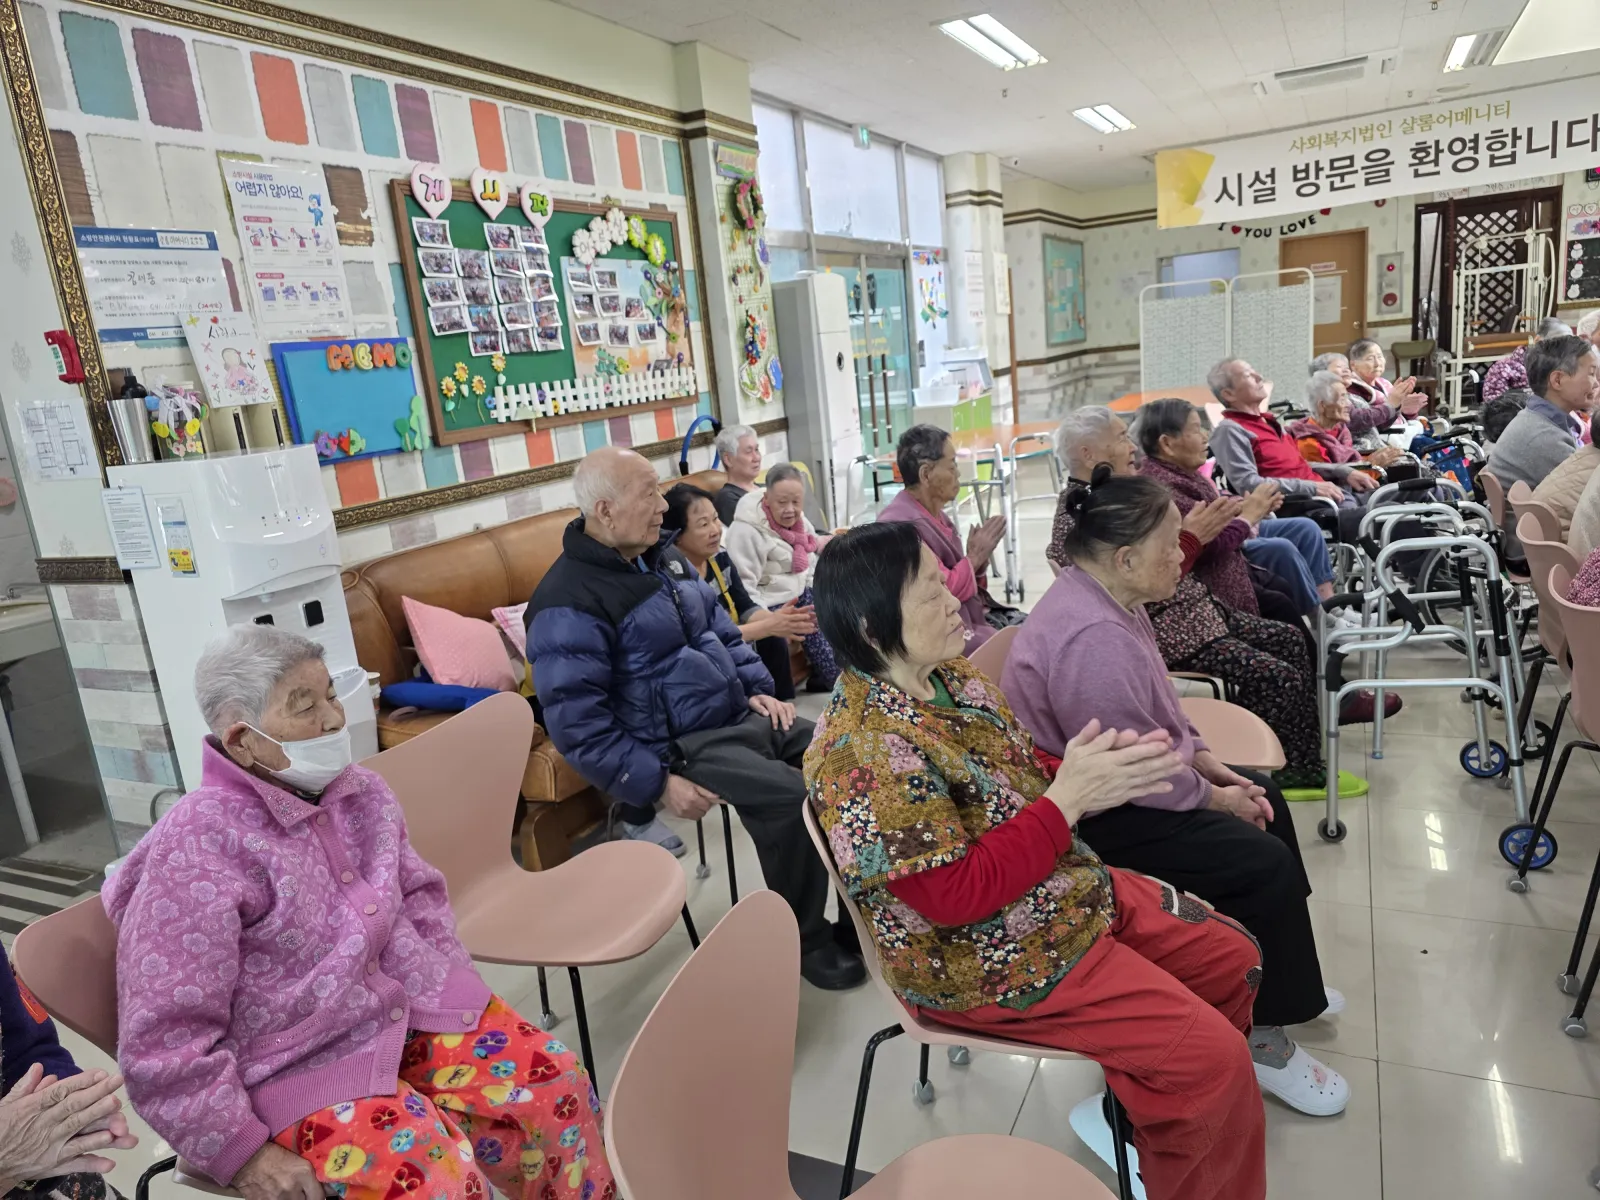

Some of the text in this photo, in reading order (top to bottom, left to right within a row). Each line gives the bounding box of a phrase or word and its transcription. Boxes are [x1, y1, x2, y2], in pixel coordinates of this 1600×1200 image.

[1288, 100, 1511, 155] 사회복지법인 샬롬어메니티
[1214, 113, 1600, 207] 시설 방문을 환영합니다
[235, 180, 304, 200] 어렵지 않아요!
[1245, 227, 1272, 238] YOU
[1280, 214, 1317, 236] LOVE
[326, 342, 412, 371] MEMO
